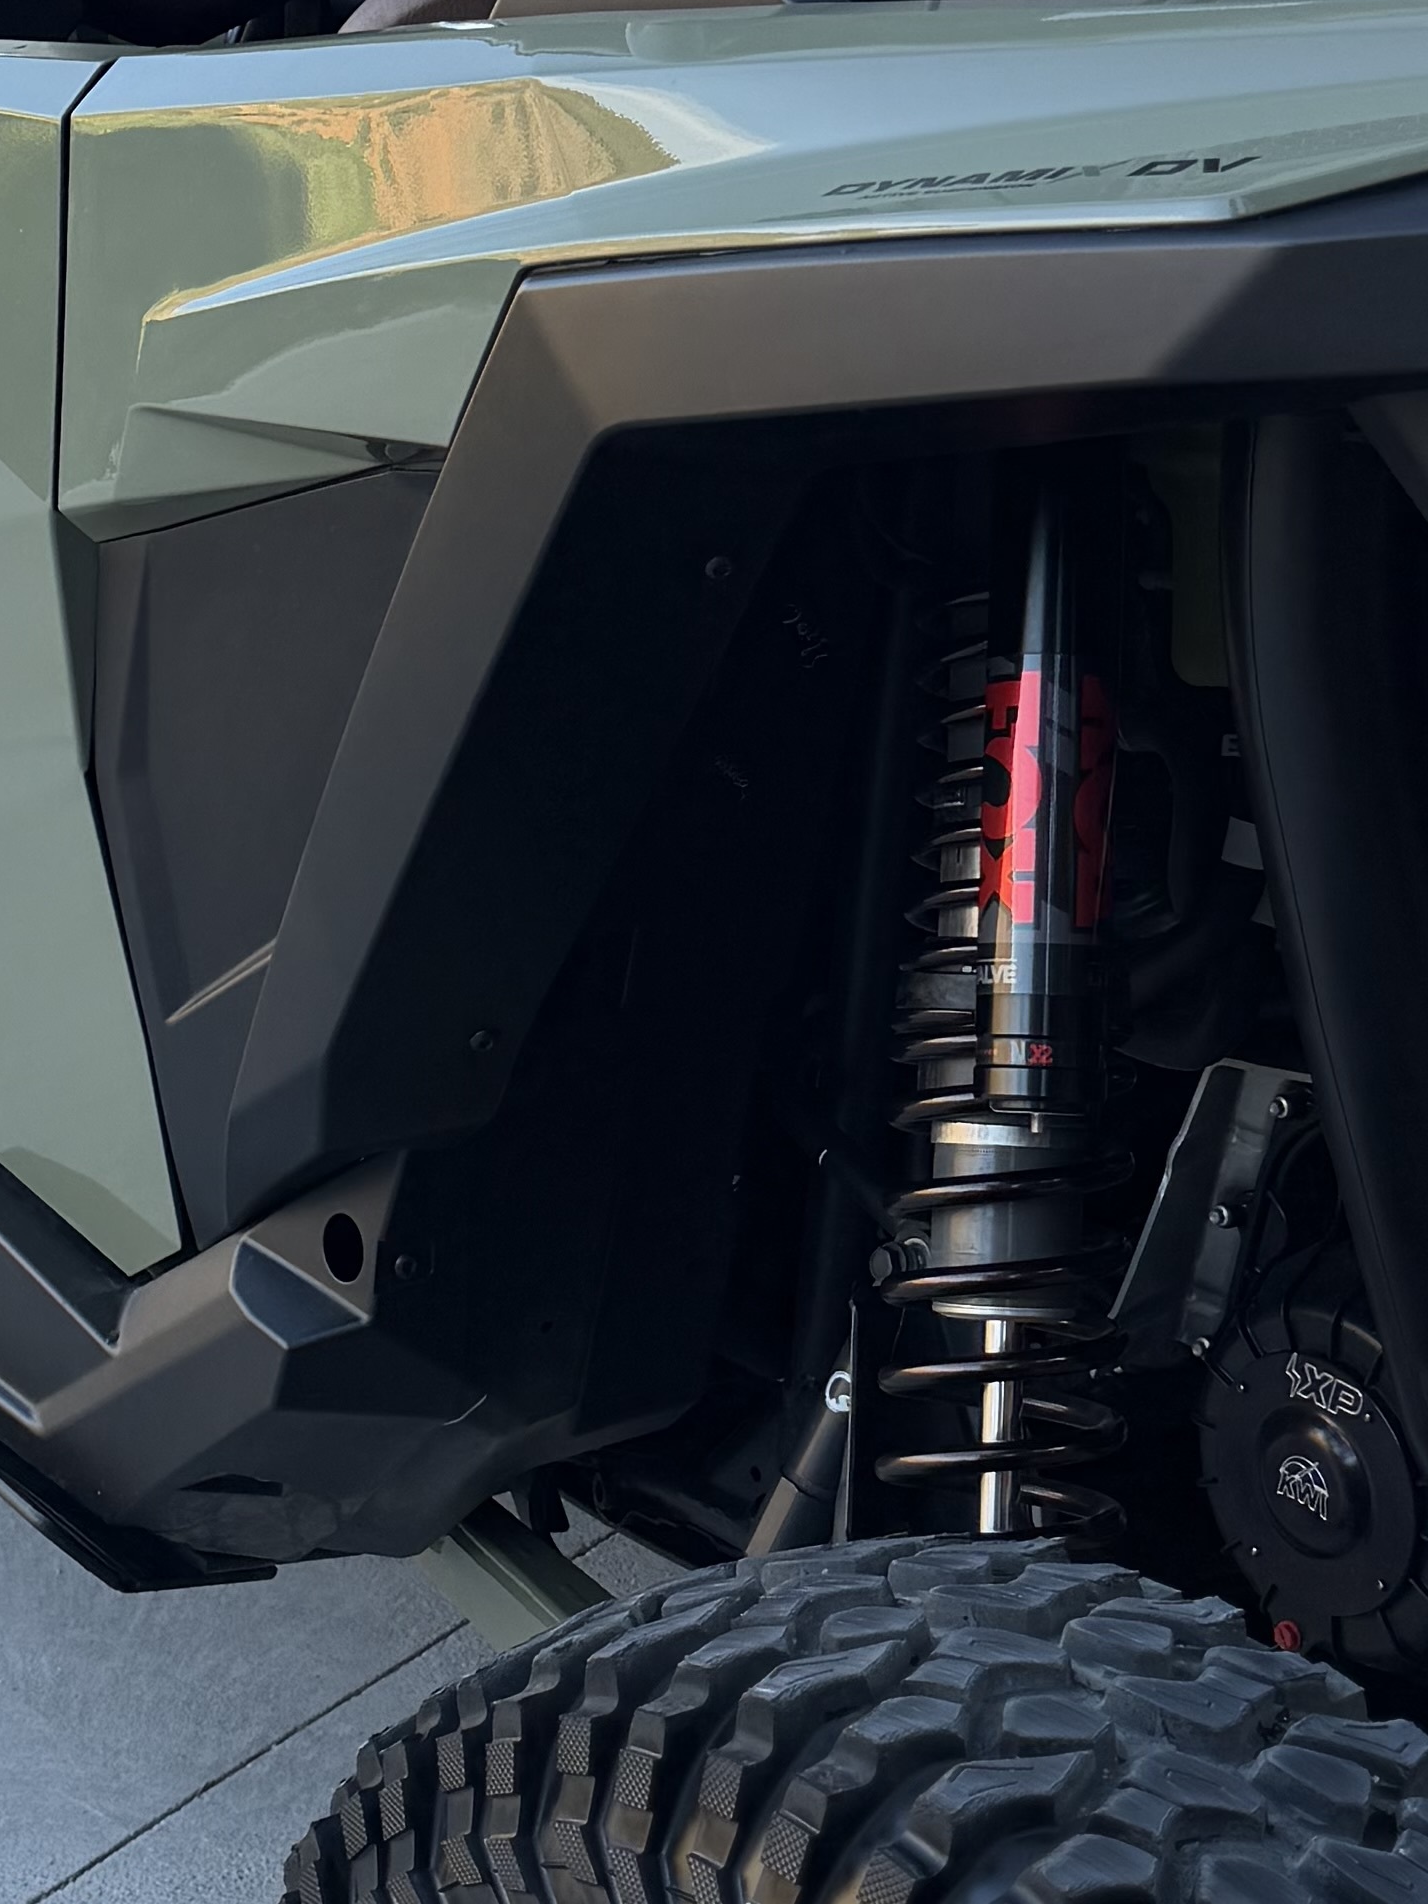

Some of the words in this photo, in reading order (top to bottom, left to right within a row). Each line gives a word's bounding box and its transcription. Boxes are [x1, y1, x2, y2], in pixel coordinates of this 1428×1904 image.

[821, 158, 1133, 198] DYNAMIX
[1126, 156, 1262, 178] DV
[977, 670, 1044, 927] FOX
[977, 963, 1018, 986] ALVE
[1296, 1362, 1364, 1416] XP
[1276, 1468, 1329, 1521] KWI
